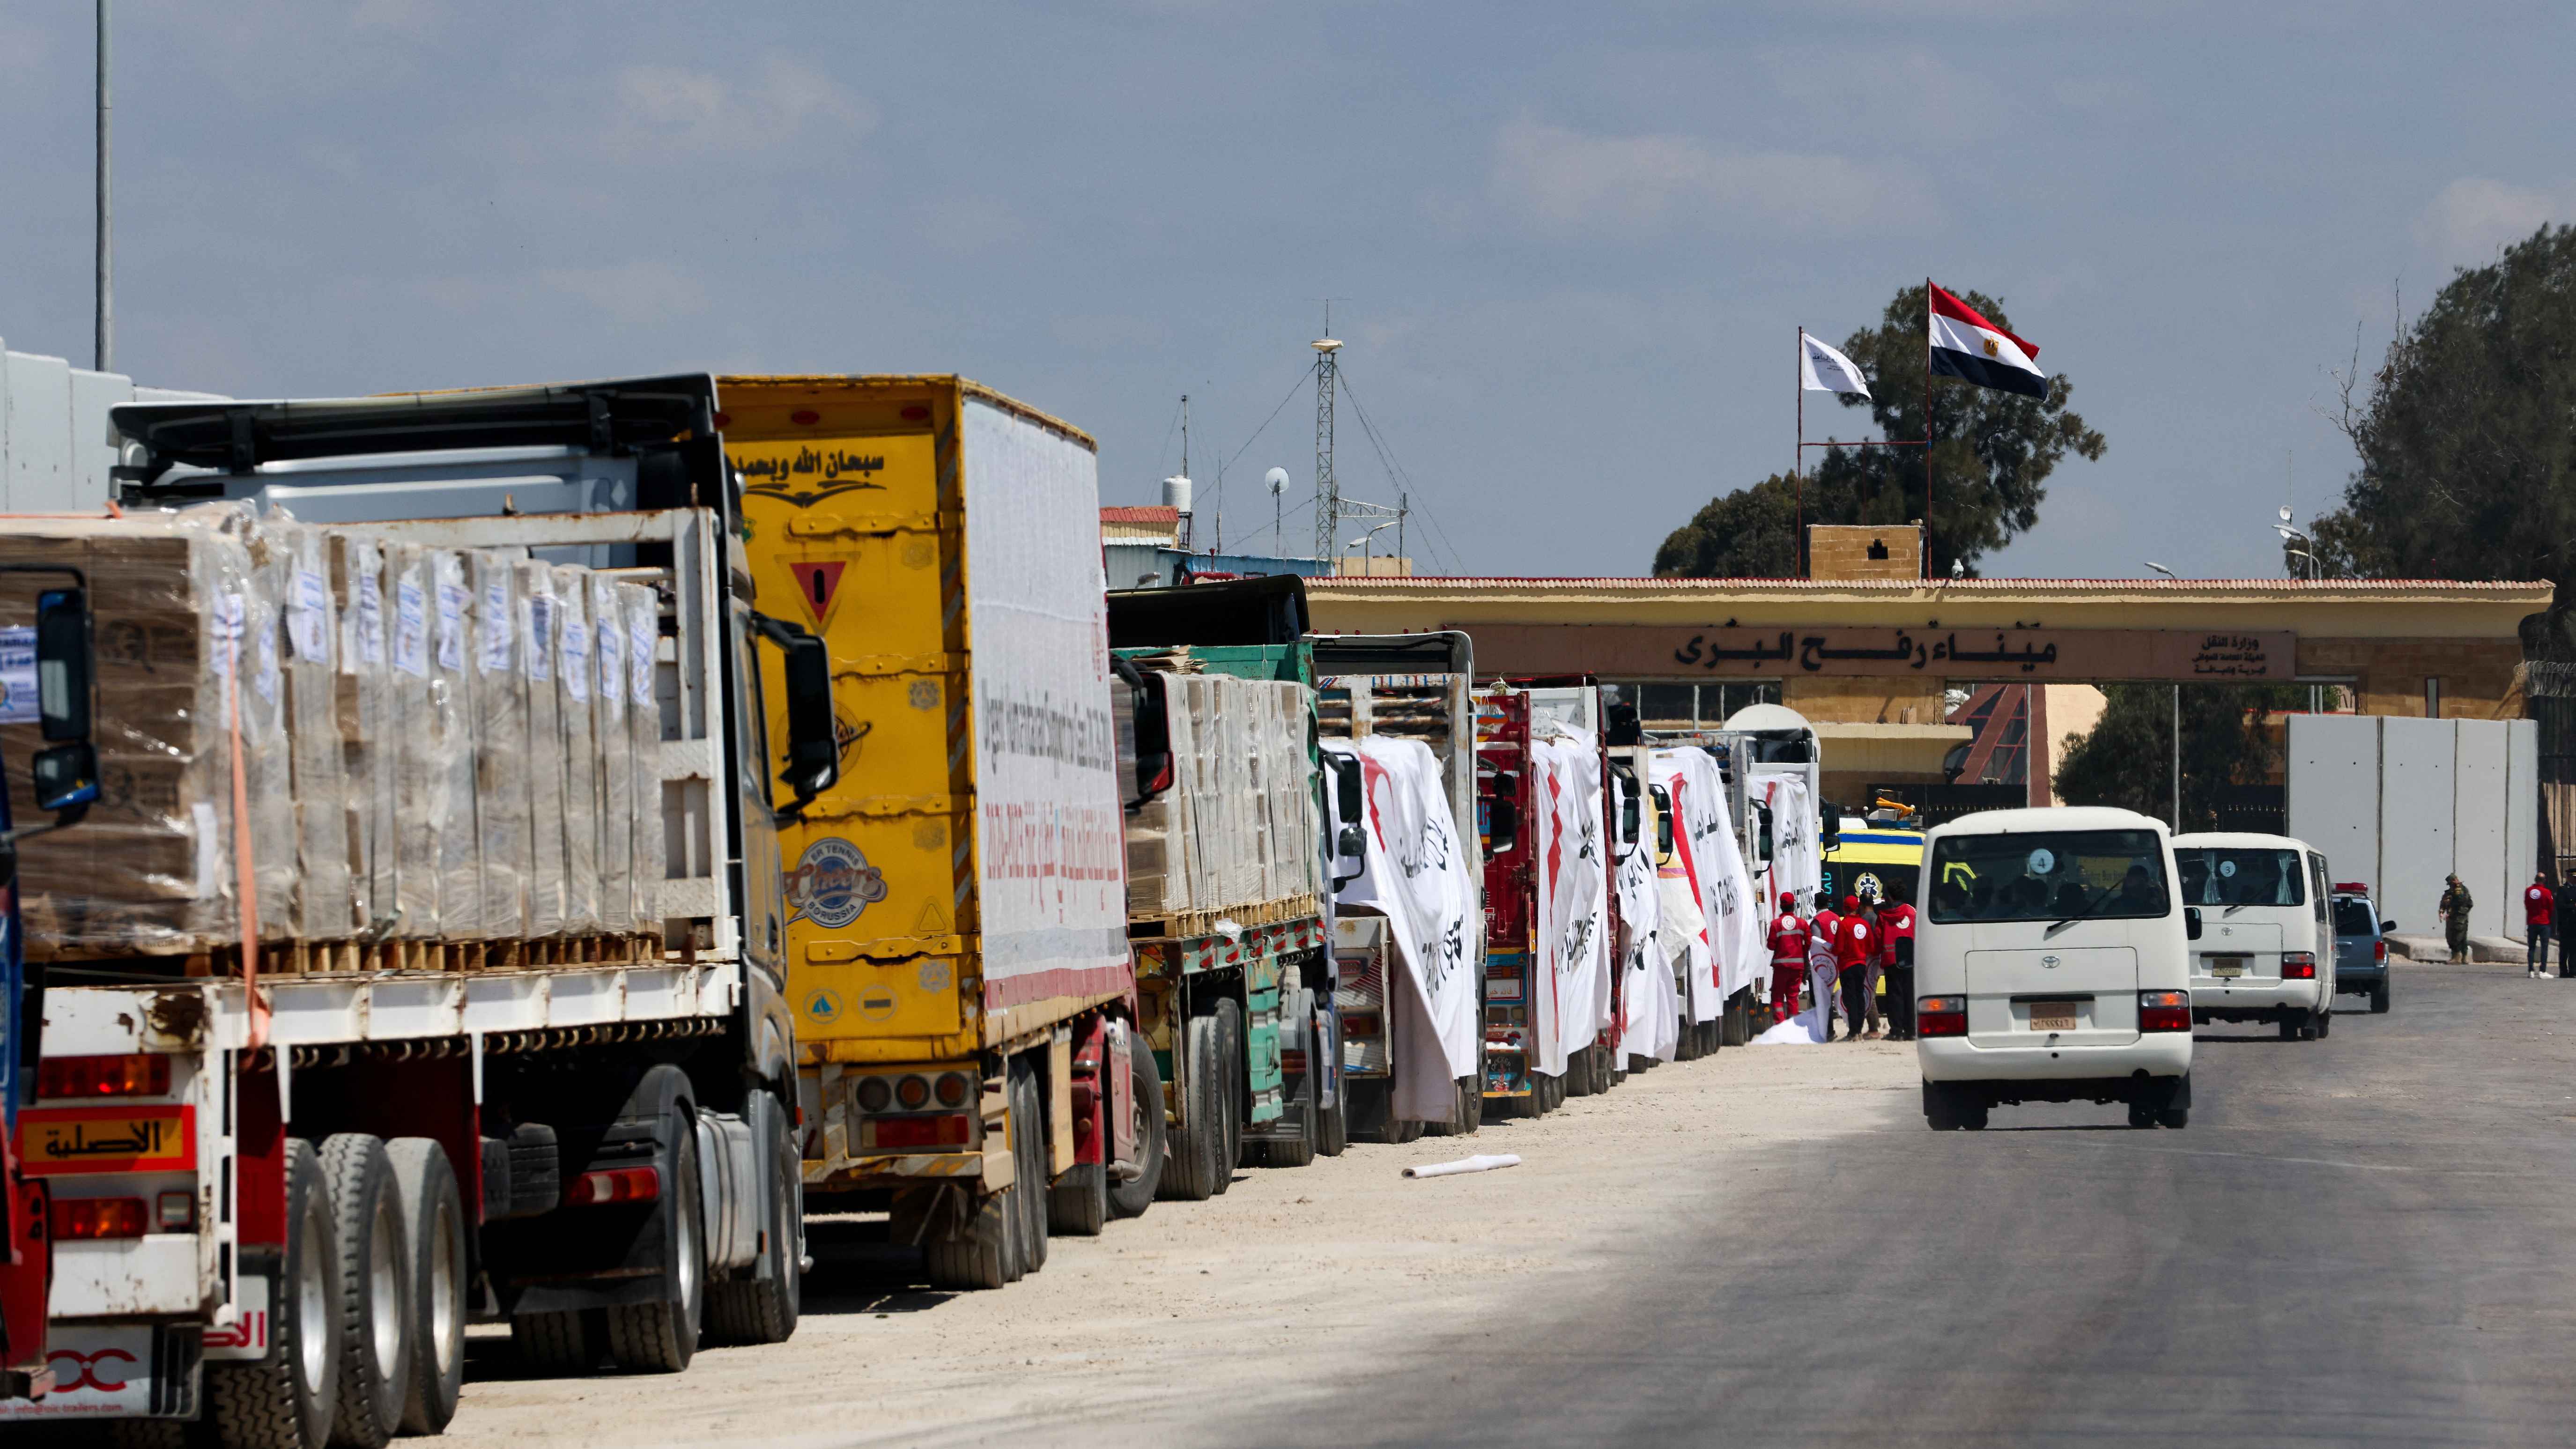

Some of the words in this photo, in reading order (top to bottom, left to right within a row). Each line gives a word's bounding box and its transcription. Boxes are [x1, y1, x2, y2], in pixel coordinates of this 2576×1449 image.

[736, 456, 789, 481] وبحمد
[792, 445, 822, 473] الله
[825, 449, 884, 479] سبحان
[1801, 629, 1926, 671] رفح
[1932, 633, 2057, 672] ميناء
[2202, 635, 2228, 650] النقل
[2232, 636, 2259, 651] وزارة
[2037, 857, 2046, 868] 4
[807, 902, 856, 920] BORUSSIA
[202, 1310, 265, 1347] الاص
